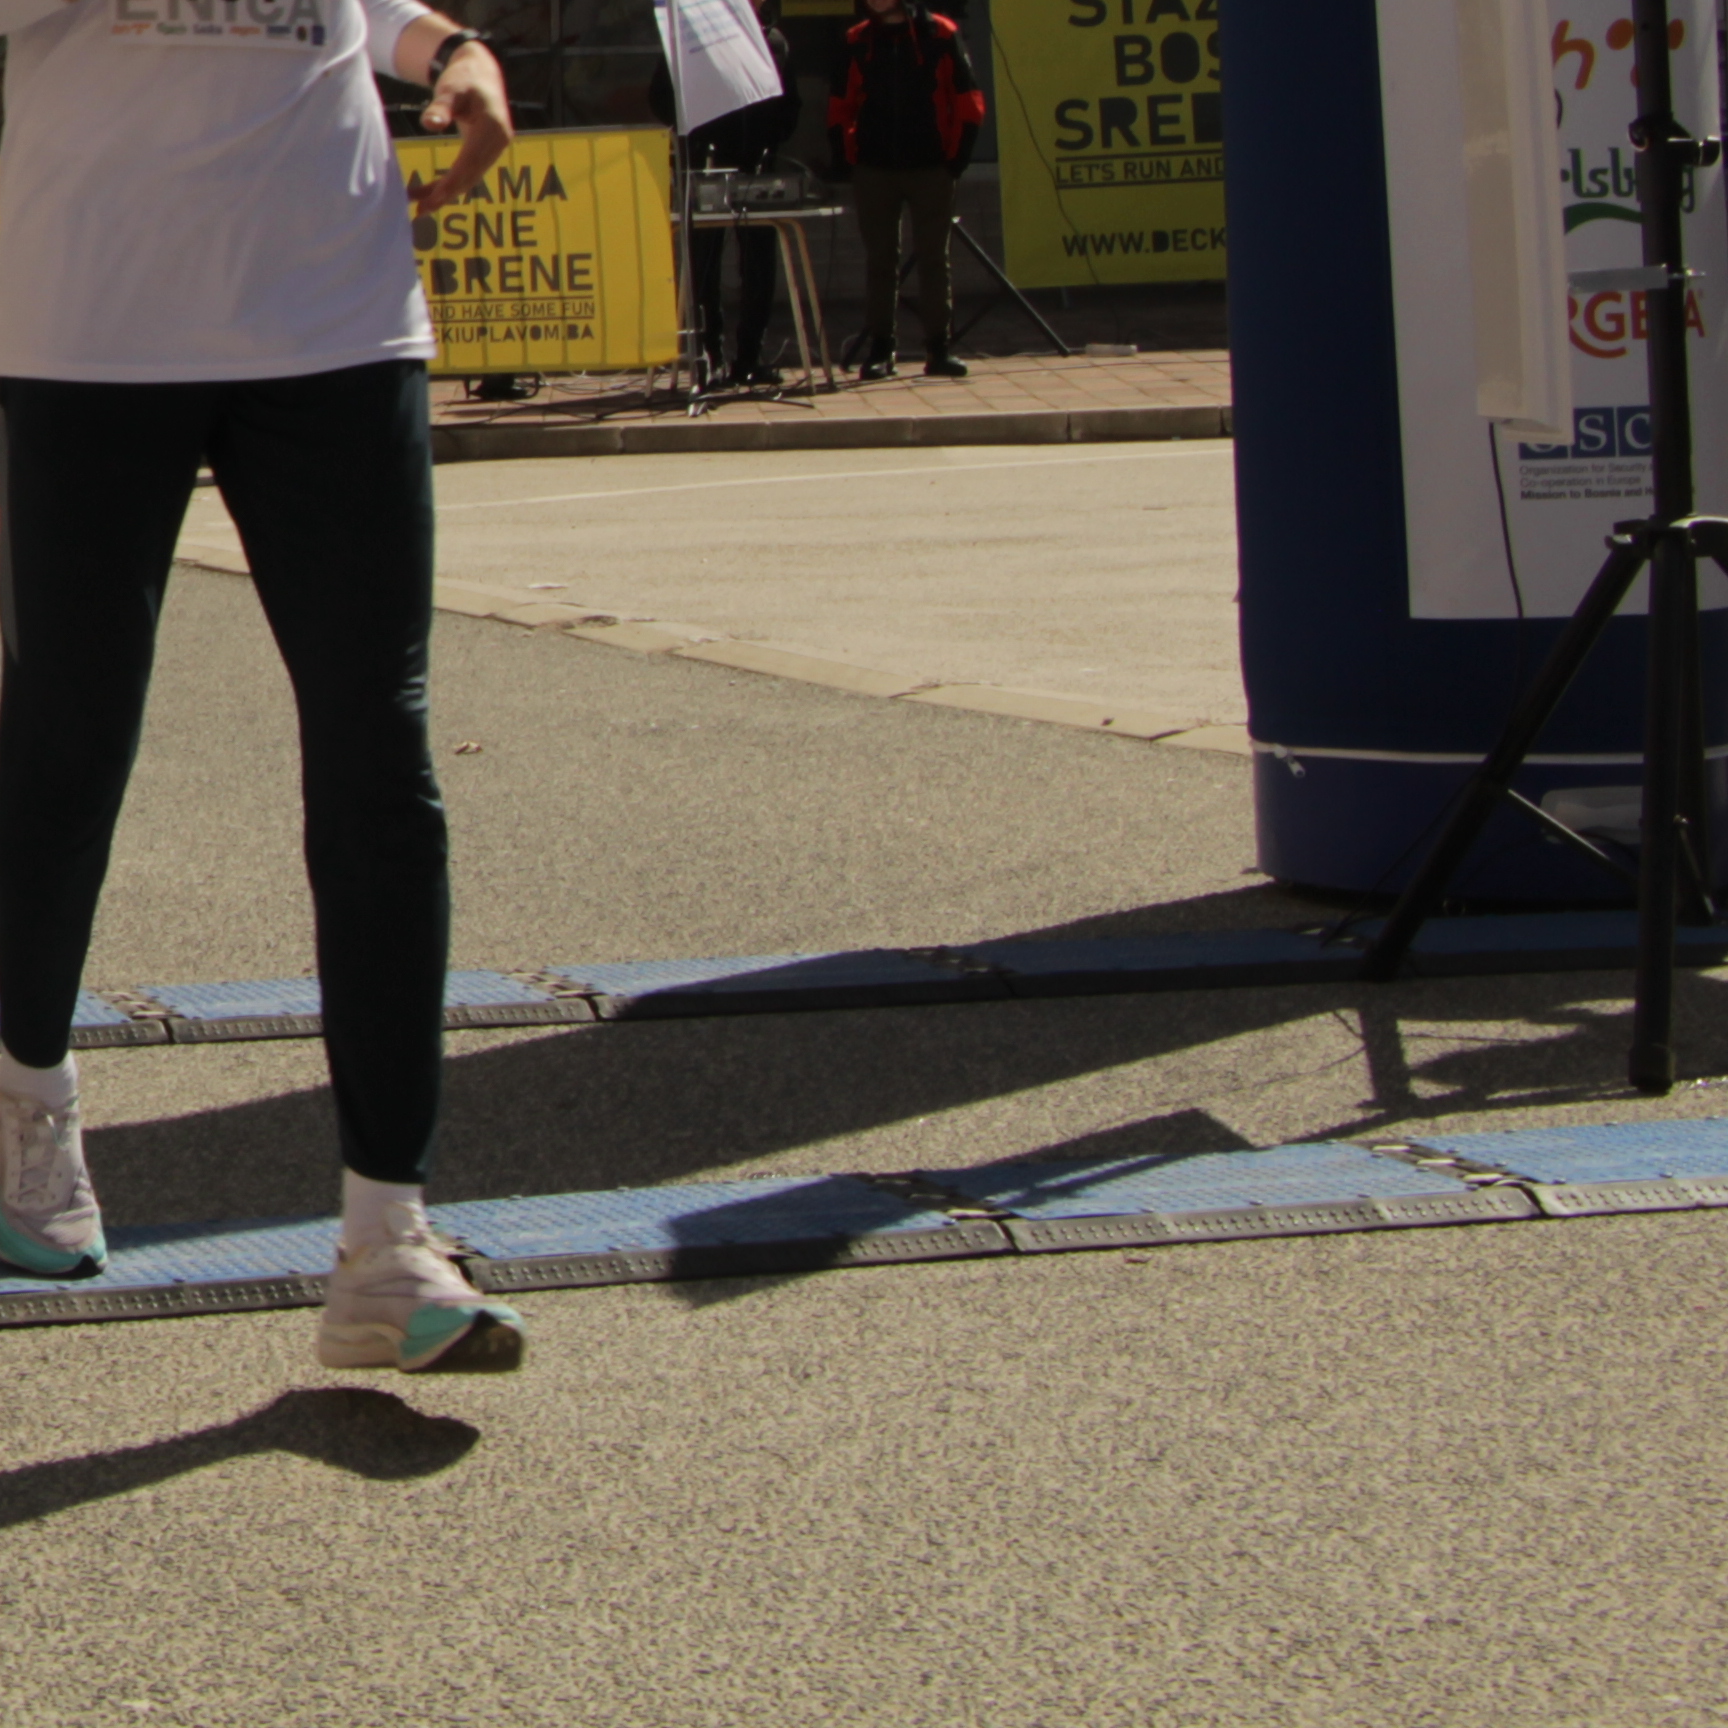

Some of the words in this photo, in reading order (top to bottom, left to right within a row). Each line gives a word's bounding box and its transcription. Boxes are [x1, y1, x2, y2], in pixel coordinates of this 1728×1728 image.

[1113, 30, 1222, 88] BOS
[1123, 159, 1173, 181] RUN
[411, 210, 538, 251] OSNE
[417, 253, 594, 296] BRENE
[460, 304, 505, 319] HAVE
[510, 302, 556, 317] SOME
[561, 301, 596, 316] FUN
